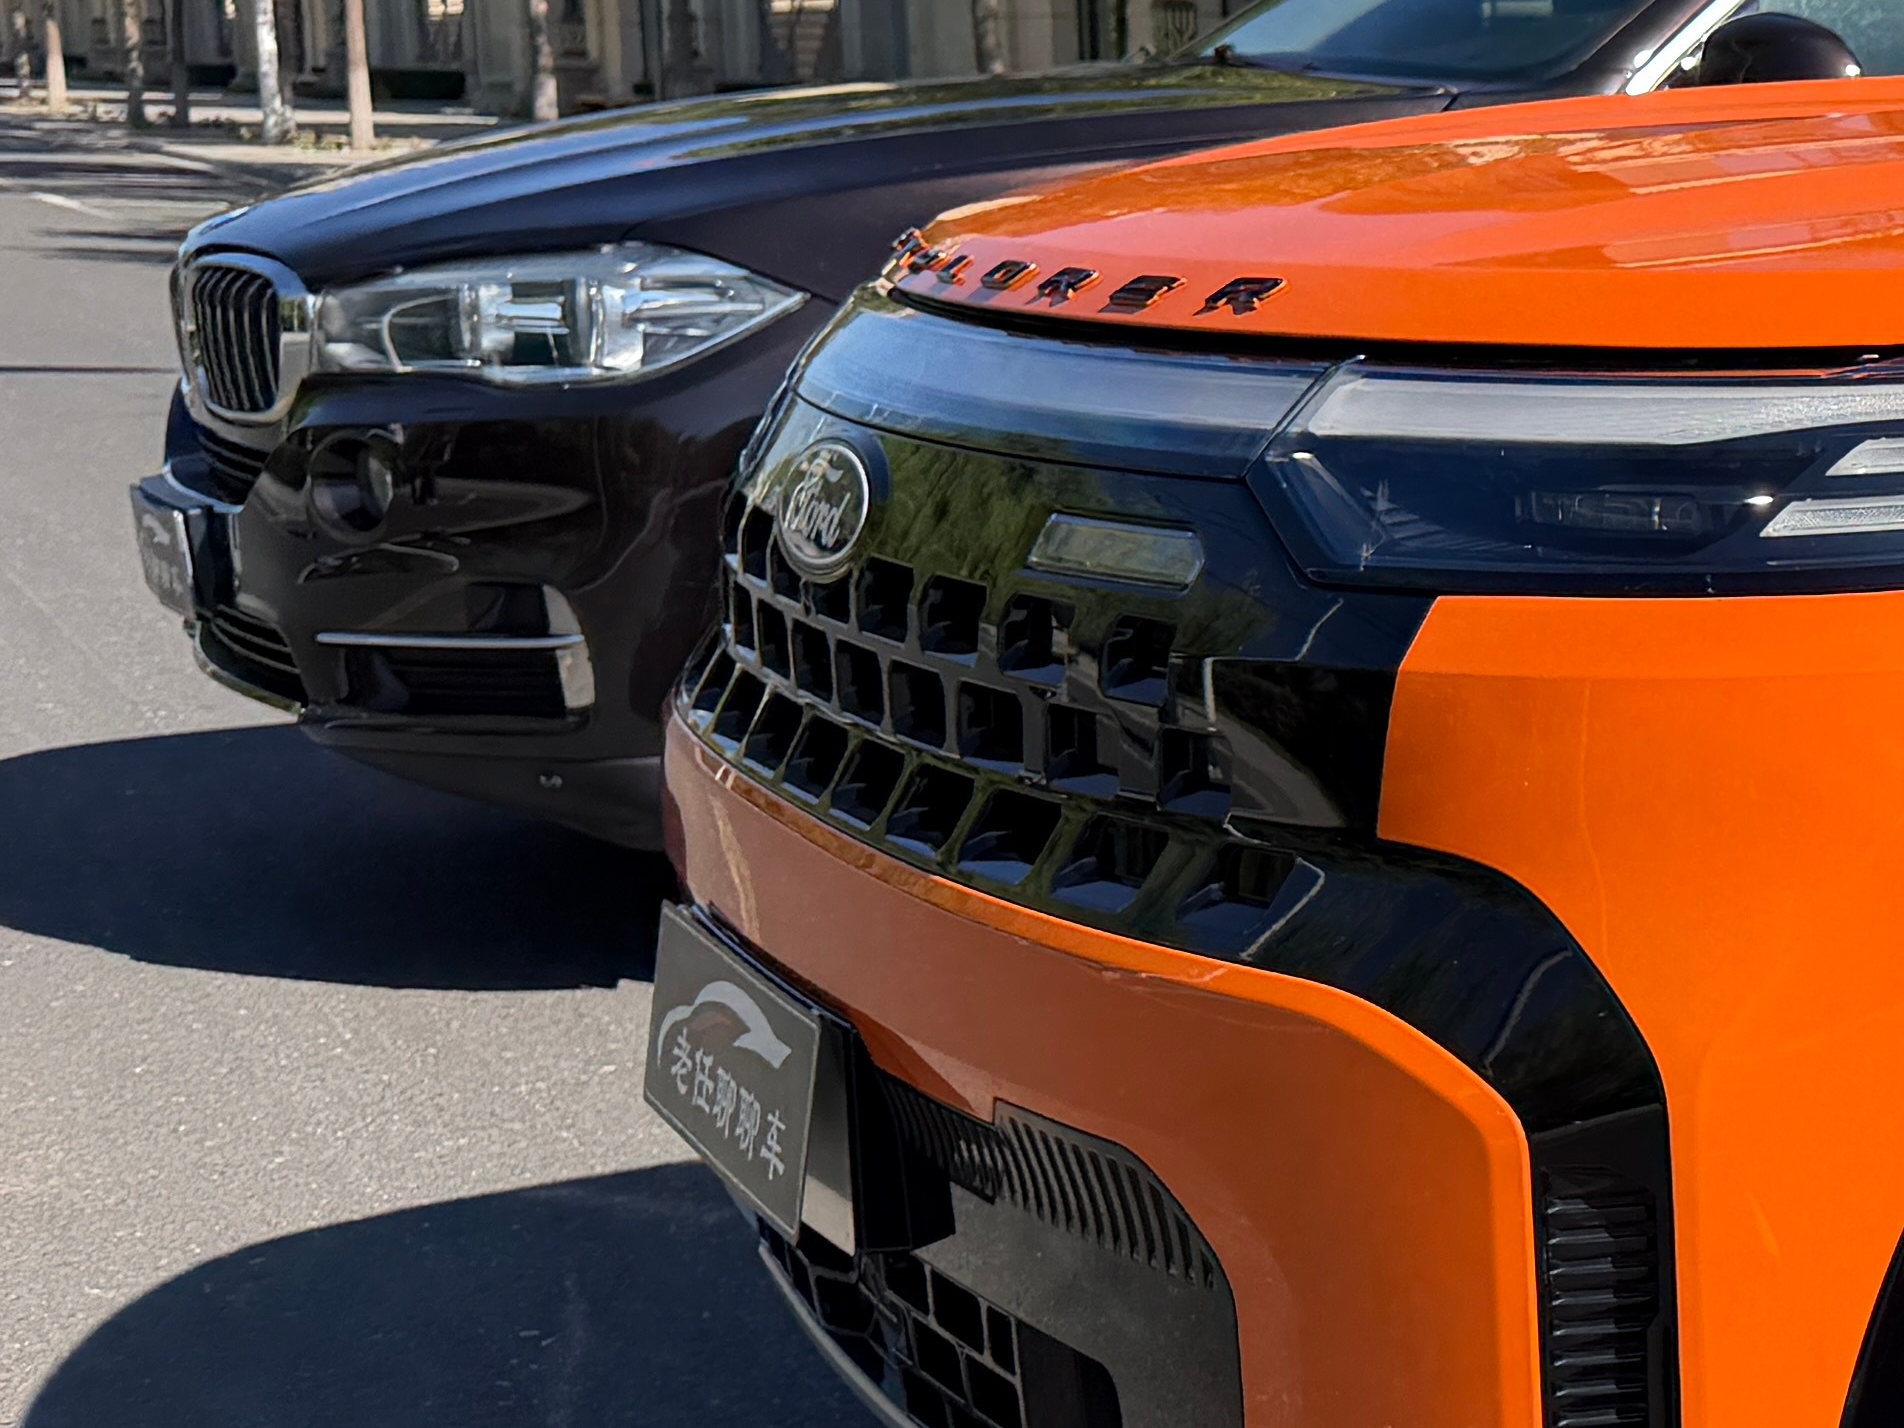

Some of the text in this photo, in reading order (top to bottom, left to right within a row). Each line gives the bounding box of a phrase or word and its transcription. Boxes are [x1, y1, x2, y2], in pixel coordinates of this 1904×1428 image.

[784, 457, 851, 549] Ford
[670, 1027, 786, 1181] 老任聊聊车
